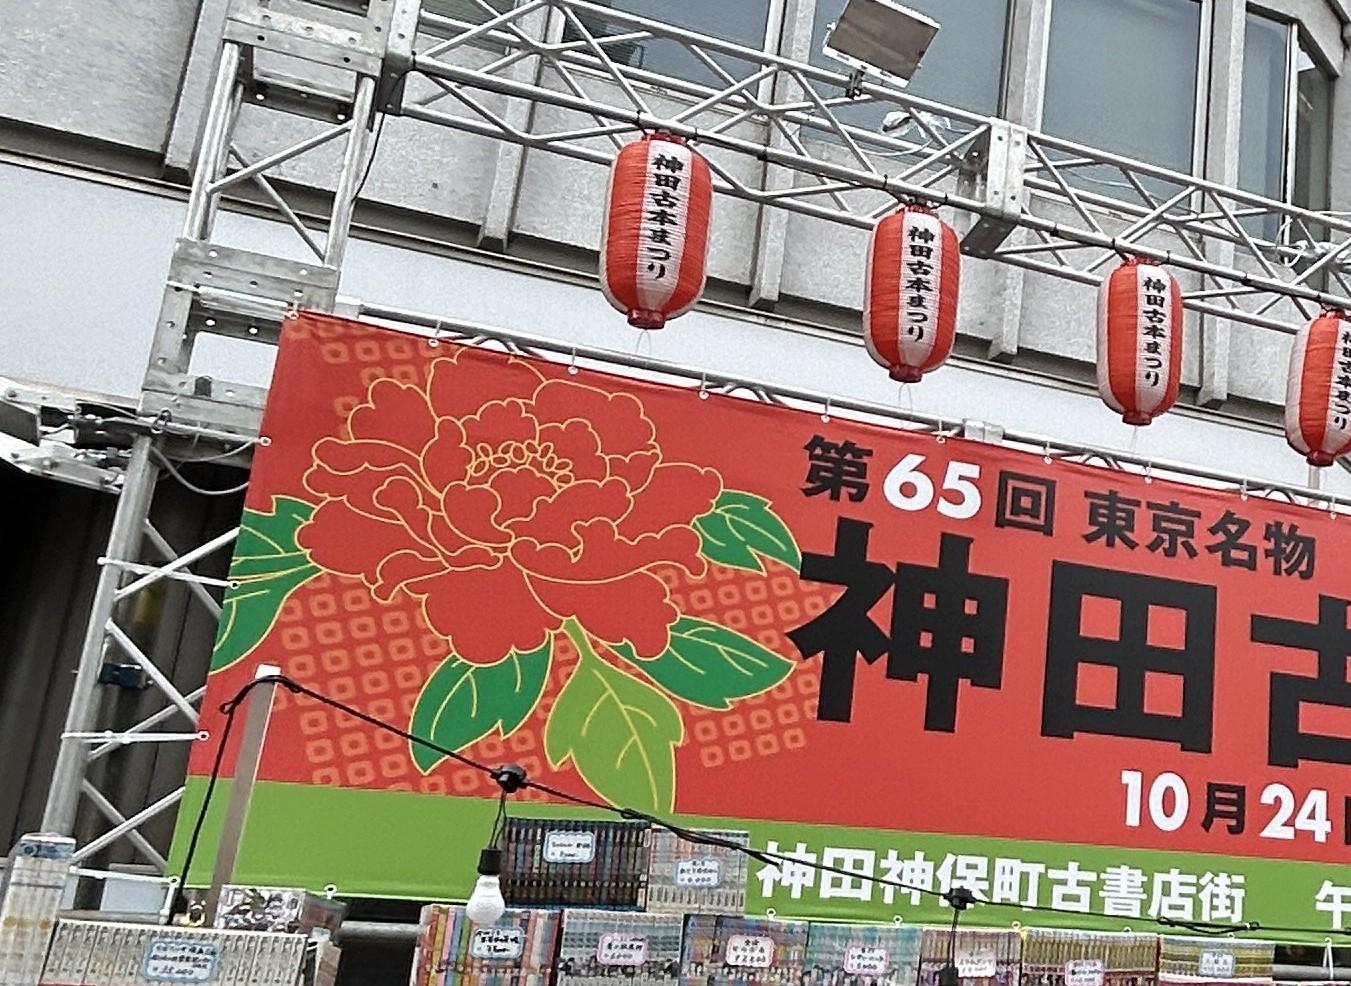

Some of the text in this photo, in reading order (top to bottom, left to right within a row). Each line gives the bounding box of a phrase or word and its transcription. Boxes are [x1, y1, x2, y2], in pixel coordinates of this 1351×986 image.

[644, 152, 686, 283] 神田古本まつり
[904, 223, 939, 344] 神田古本まつり
[1141, 276, 1168, 388] 神田古本まつり
[800, 434, 1317, 581] 第65回 東京名物
[756, 840, 1246, 923] 神田神保町古書店街
